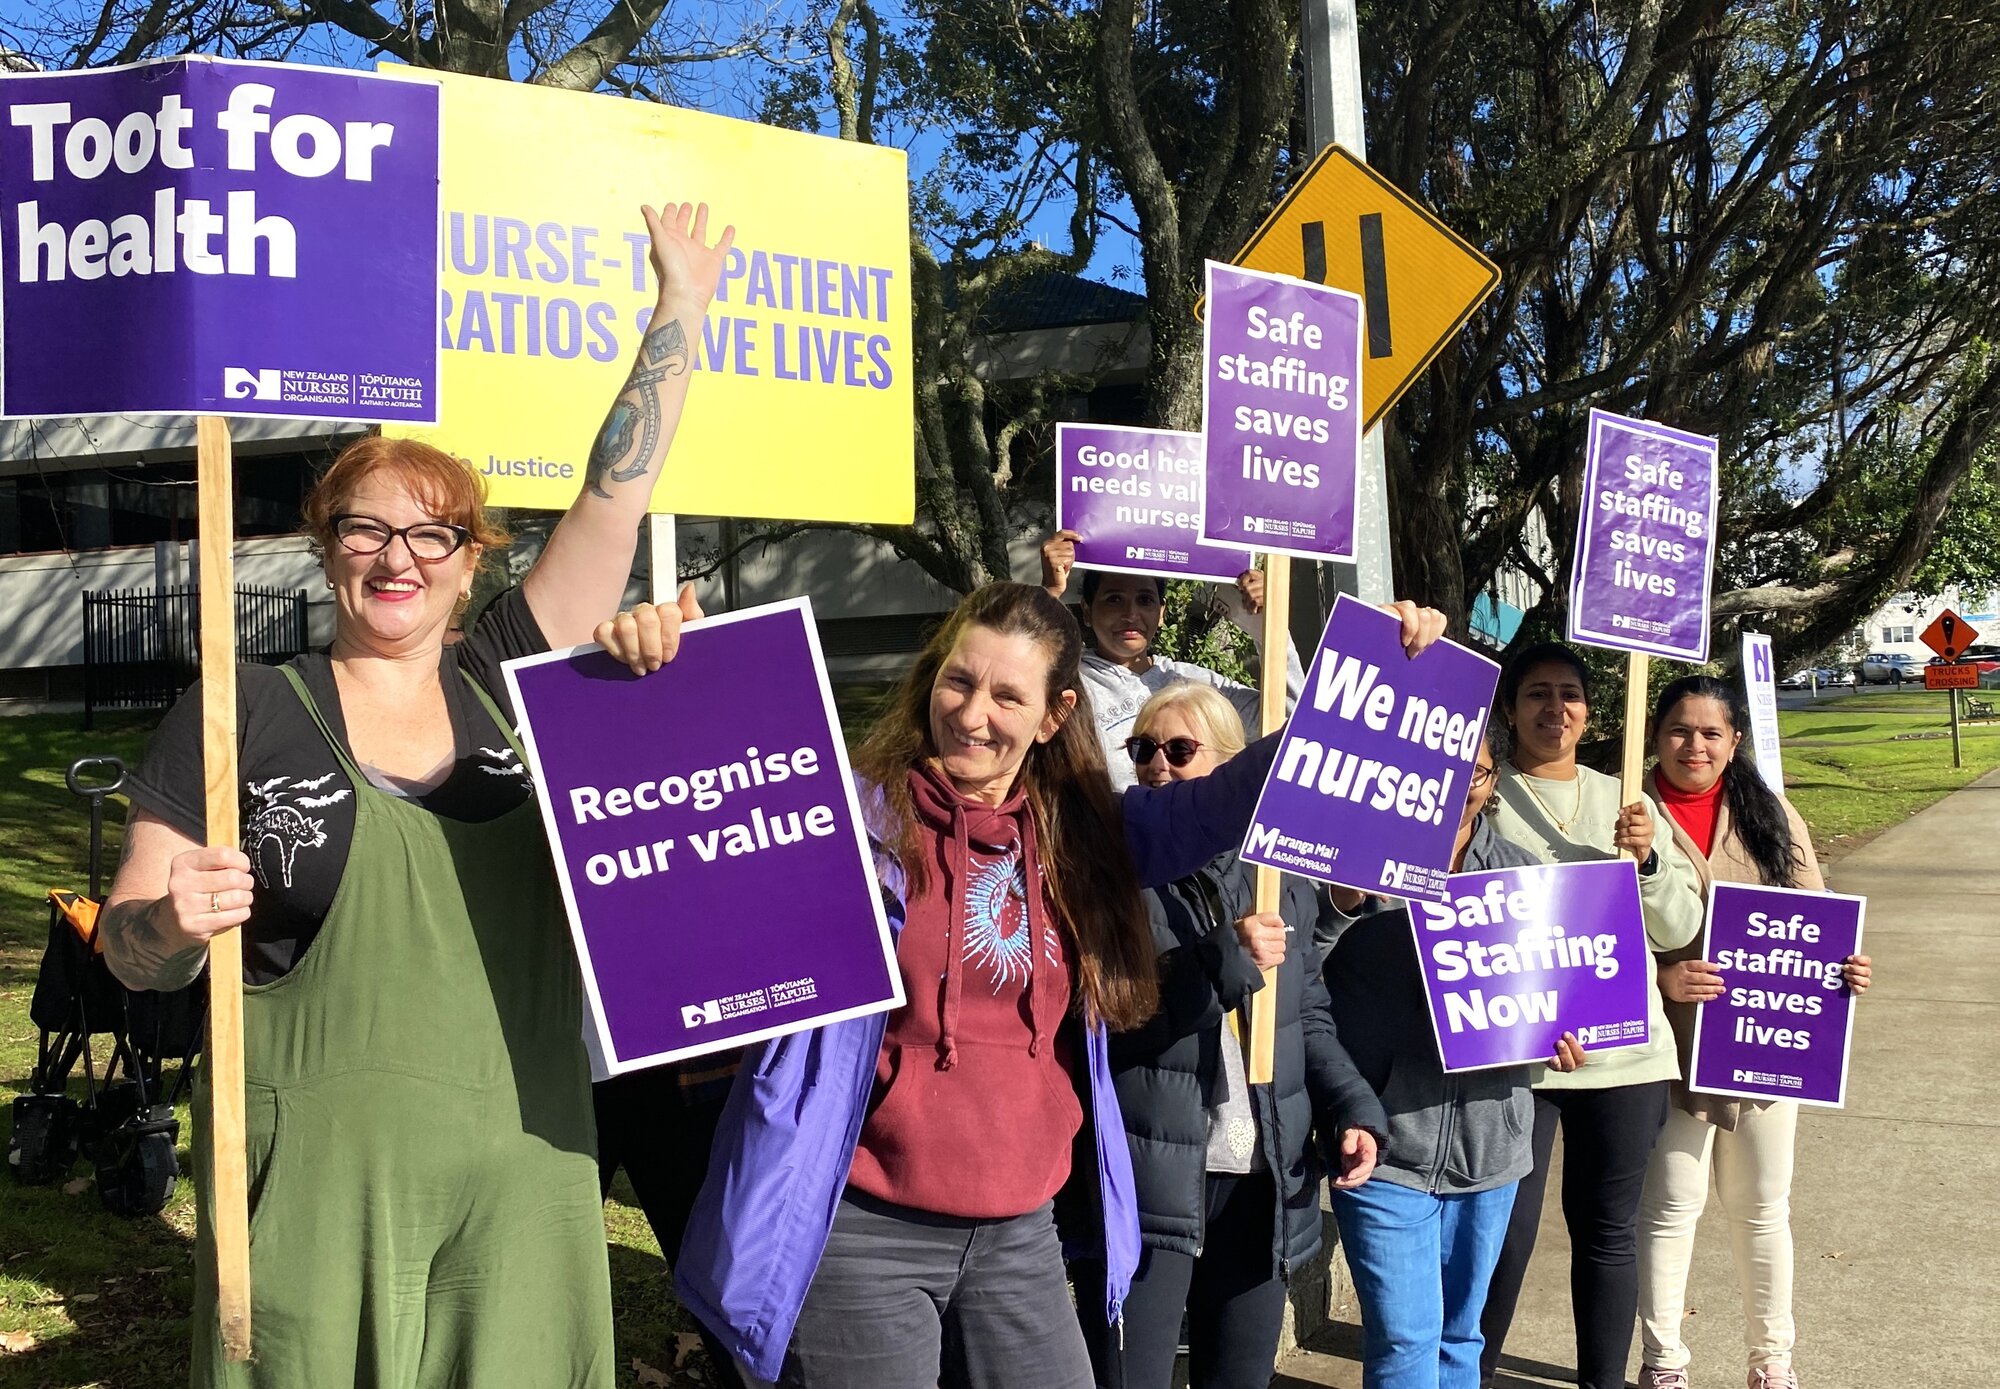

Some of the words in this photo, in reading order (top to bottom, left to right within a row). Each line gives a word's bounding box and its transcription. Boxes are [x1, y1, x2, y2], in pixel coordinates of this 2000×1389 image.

[10, 94, 194, 182] Toot
[217, 82, 395, 182] for
[18, 187, 297, 282] health
[1246, 305, 1323, 350] Safe
[636, 306, 759, 376] VE
[773, 322, 893, 390] LIVES
[283, 371, 305, 379] NEW
[307, 371, 349, 381] ZEALAND
[283, 380, 349, 395] NURSES
[359, 385, 422, 400] TAPUHI
[1217, 351, 1350, 411] staffing
[283, 393, 349, 404] ORGANISATION
[1234, 405, 1329, 443] saves
[480, 455, 574, 478] Justice
[1077, 445, 1150, 471] Good
[1242, 444, 1320, 489] lives
[1624, 454, 1684, 491] Safe
[1071, 475, 1152, 497] needs
[1158, 480, 1200, 502] val
[1116, 505, 1200, 530] nurses
[1599, 488, 1703, 538] staffing
[1610, 529, 1685, 563] saves
[1614, 560, 1676, 598] lives
[1929, 677, 1975, 687] CROSSING
[1931, 667, 1970, 676] TRUCKS
[1313, 646, 1395, 731] We
[1398, 695, 1487, 764] need
[568, 745, 820, 825] Recognise
[1276, 735, 1455, 827] nurses!
[585, 836, 674, 887] our
[687, 803, 836, 863] value
[1245, 822, 1314, 859] Maranga
[1403, 872, 1427, 885] NURSES
[1421, 879, 1537, 931] Safe
[1746, 911, 1821, 943] Safe
[1432, 925, 1619, 982] Staffing
[1717, 947, 1844, 990] staffing
[719, 996, 734, 1005] NEW
[734, 989, 764, 1002] ZEALAND
[721, 995, 766, 1014] NURSES
[771, 983, 817, 1002] TAPUHI
[1730, 987, 1823, 1016] saves
[722, 1004, 767, 1020] ORGANISATION
[1443, 988, 1558, 1034] Now
[1734, 1017, 1811, 1051] lives
